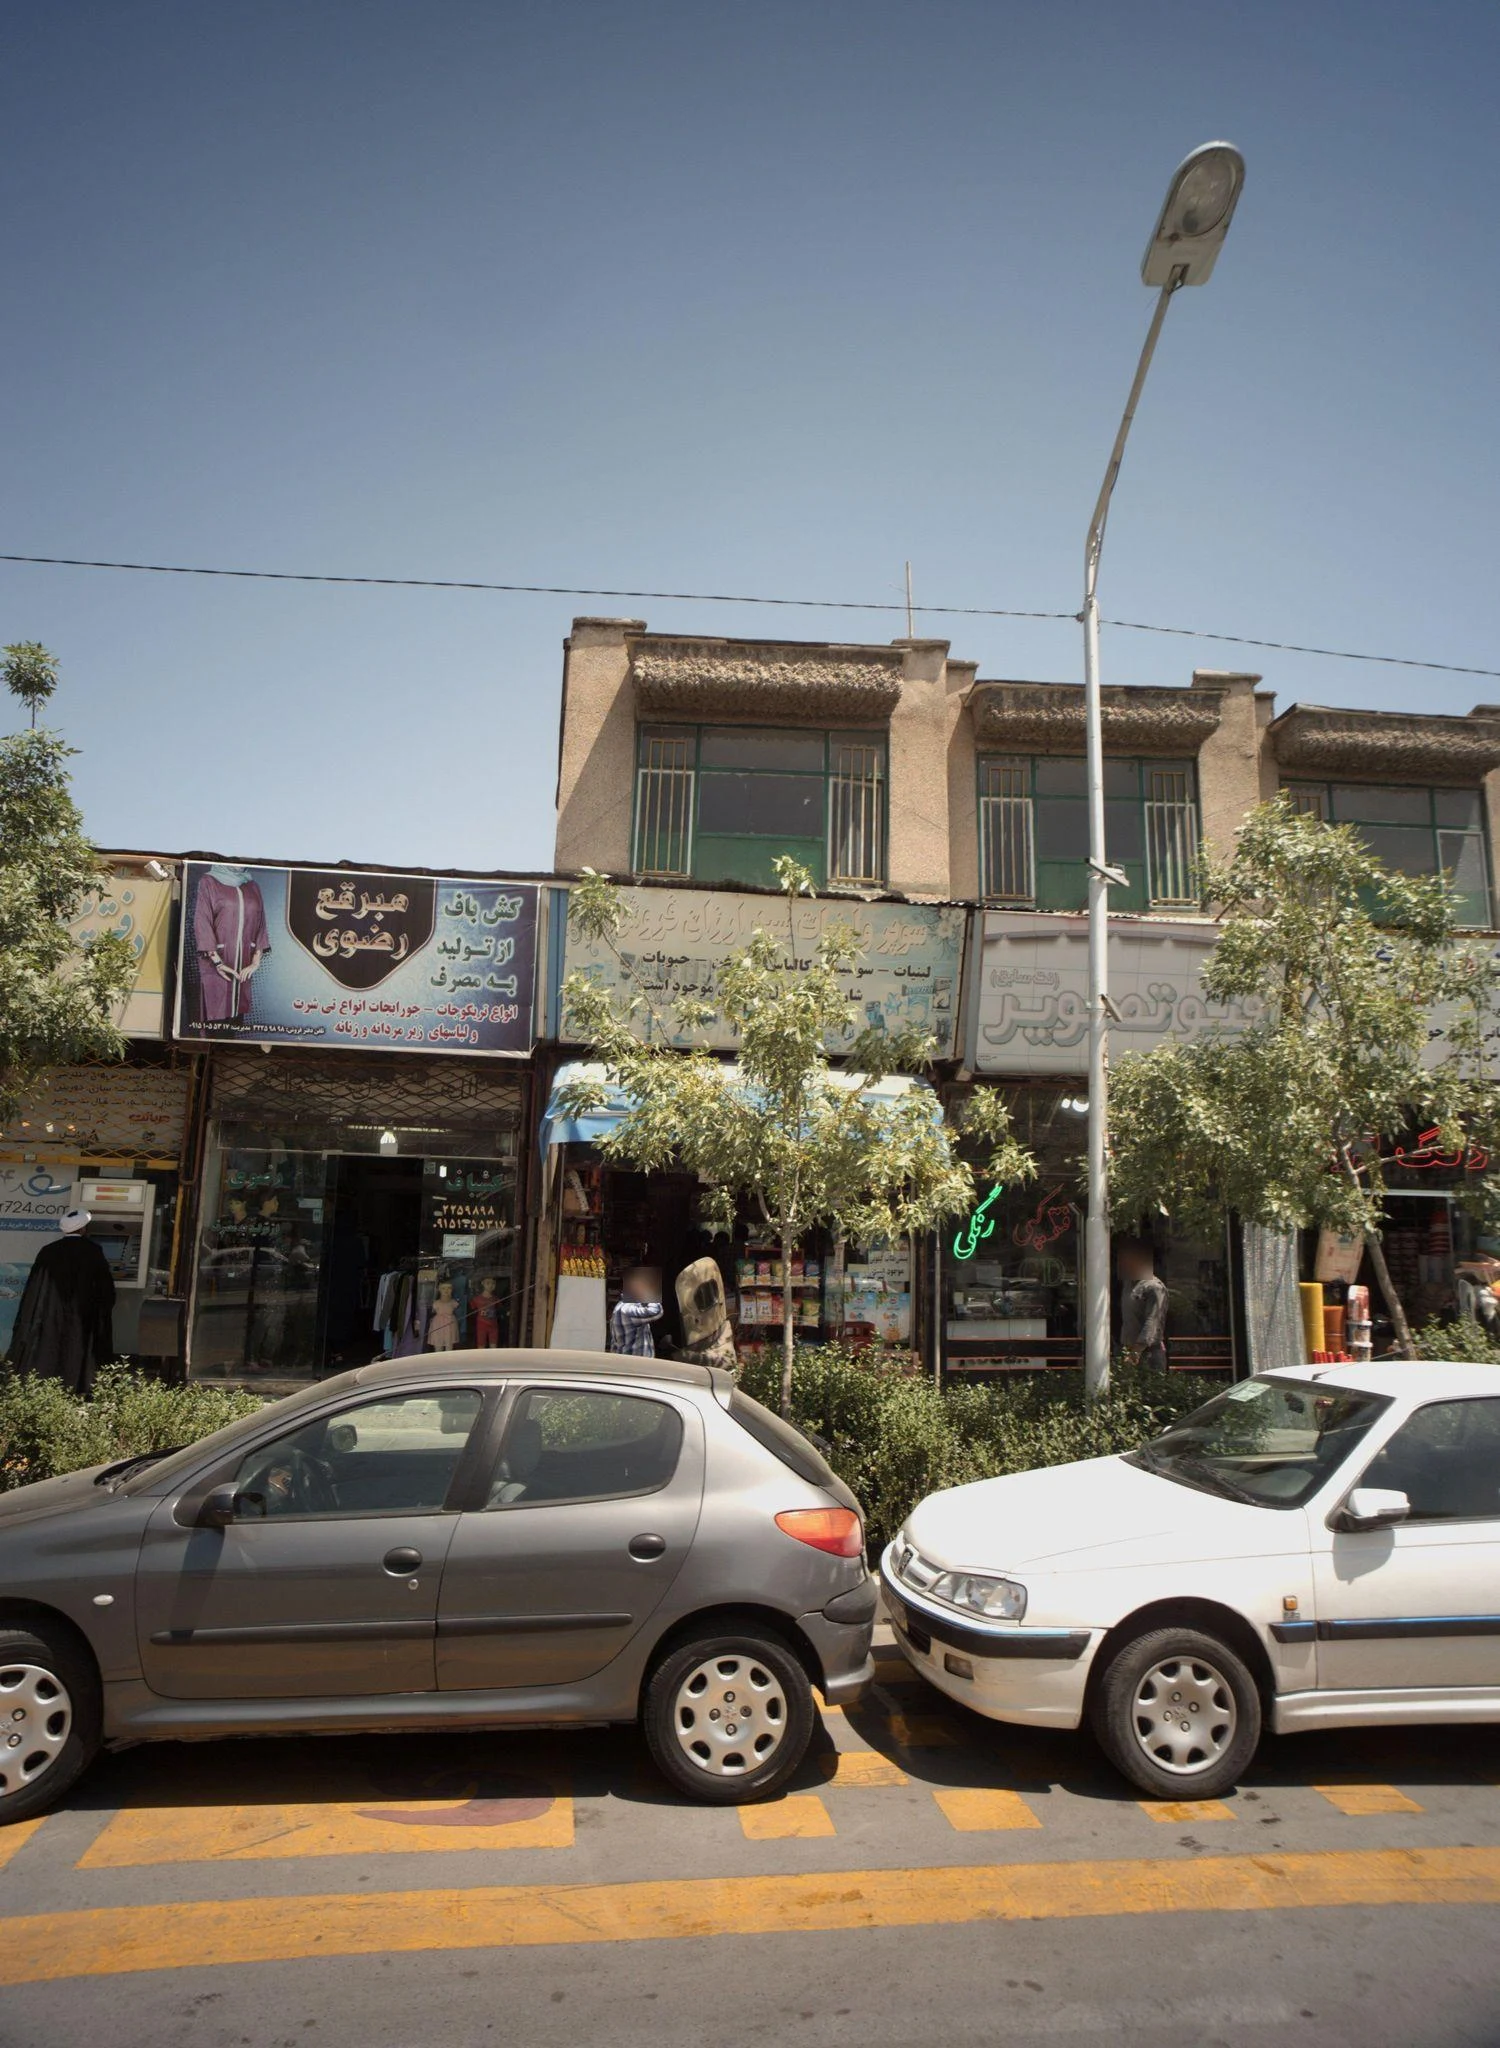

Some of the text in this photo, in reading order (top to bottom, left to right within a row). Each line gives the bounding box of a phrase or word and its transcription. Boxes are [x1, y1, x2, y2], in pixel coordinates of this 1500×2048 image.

[315, 881, 409, 921] مبرقع
[444, 891, 523, 924] کش باف
[312, 923, 409, 960] رضوی
[437, 936, 514, 962] از تولید
[642, 950, 690, 968] حبوبات
[430, 966, 517, 996] به مصرف
[893, 964, 931, 981] لبنیات
[643, 979, 669, 991] است
[672, 981, 714, 997] موجود
[293, 998, 319, 1014] شرت
[320, 999, 336, 1014] تی
[339, 999, 366, 1016] انواع
[487, 1004, 518, 1023] انواع
[335, 1020, 478, 1043] و لباسهای زیر مردانه و زنانه
